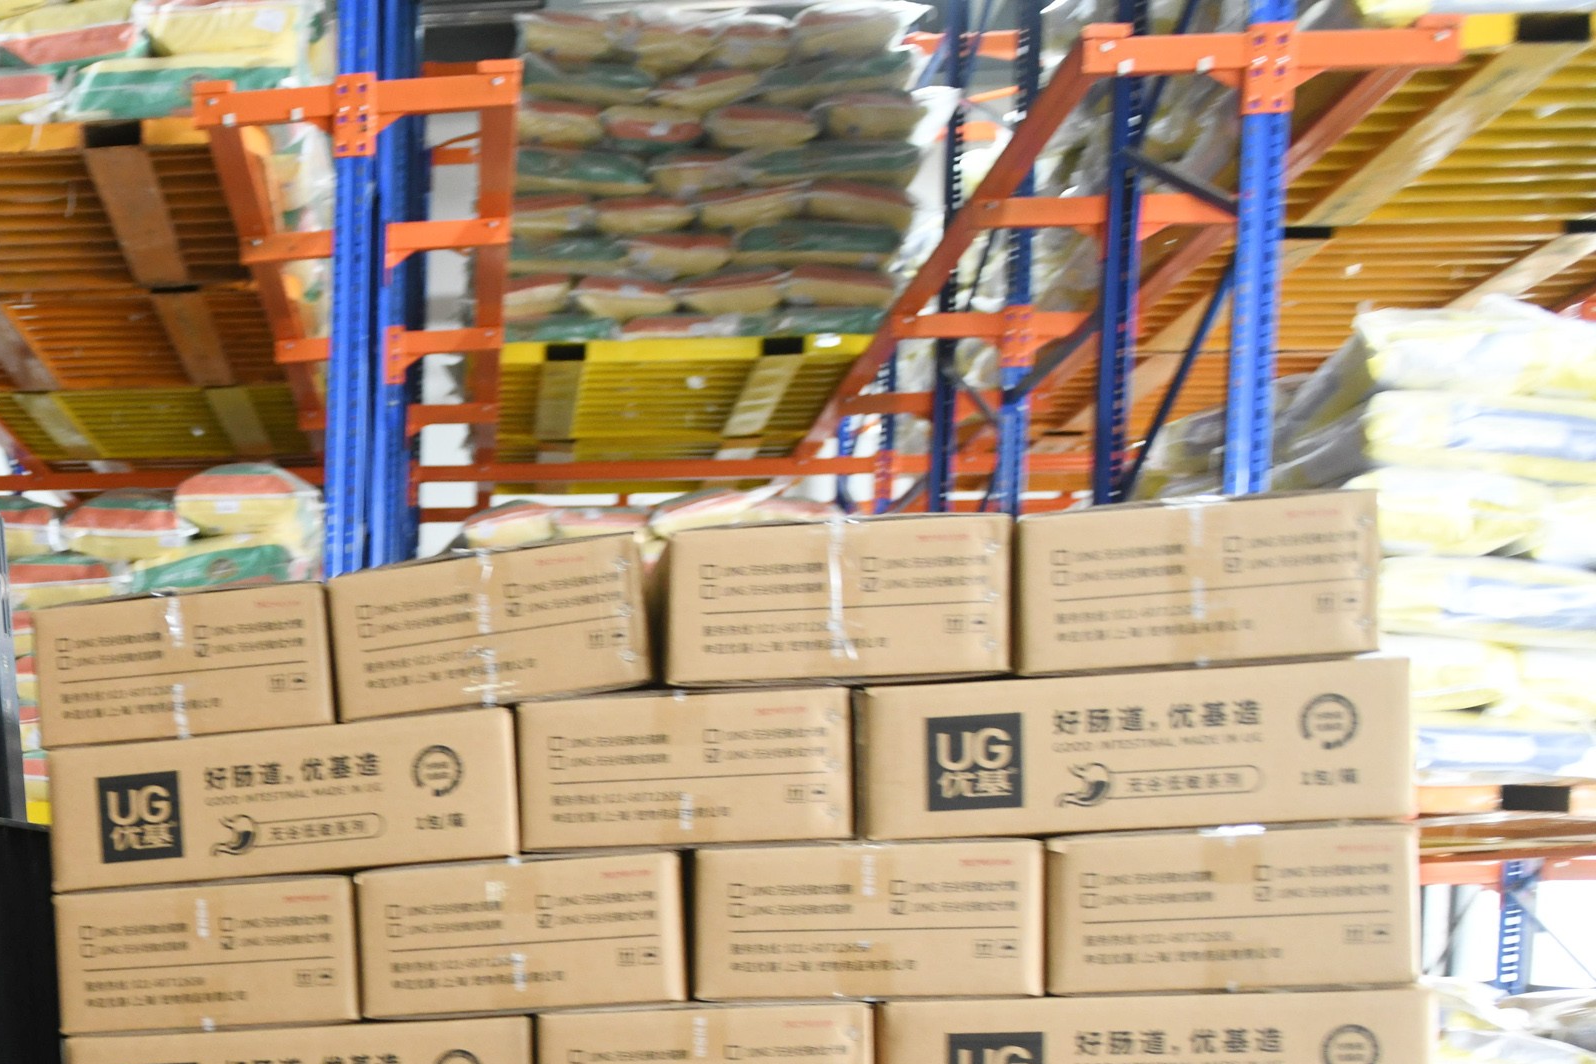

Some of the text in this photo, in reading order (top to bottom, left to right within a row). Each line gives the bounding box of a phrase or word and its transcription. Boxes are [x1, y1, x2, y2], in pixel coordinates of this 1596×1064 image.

[935, 728, 1014, 772] UG
[937, 769, 1014, 799] 优基
[107, 784, 172, 826] UG
[110, 823, 175, 851] 优基
